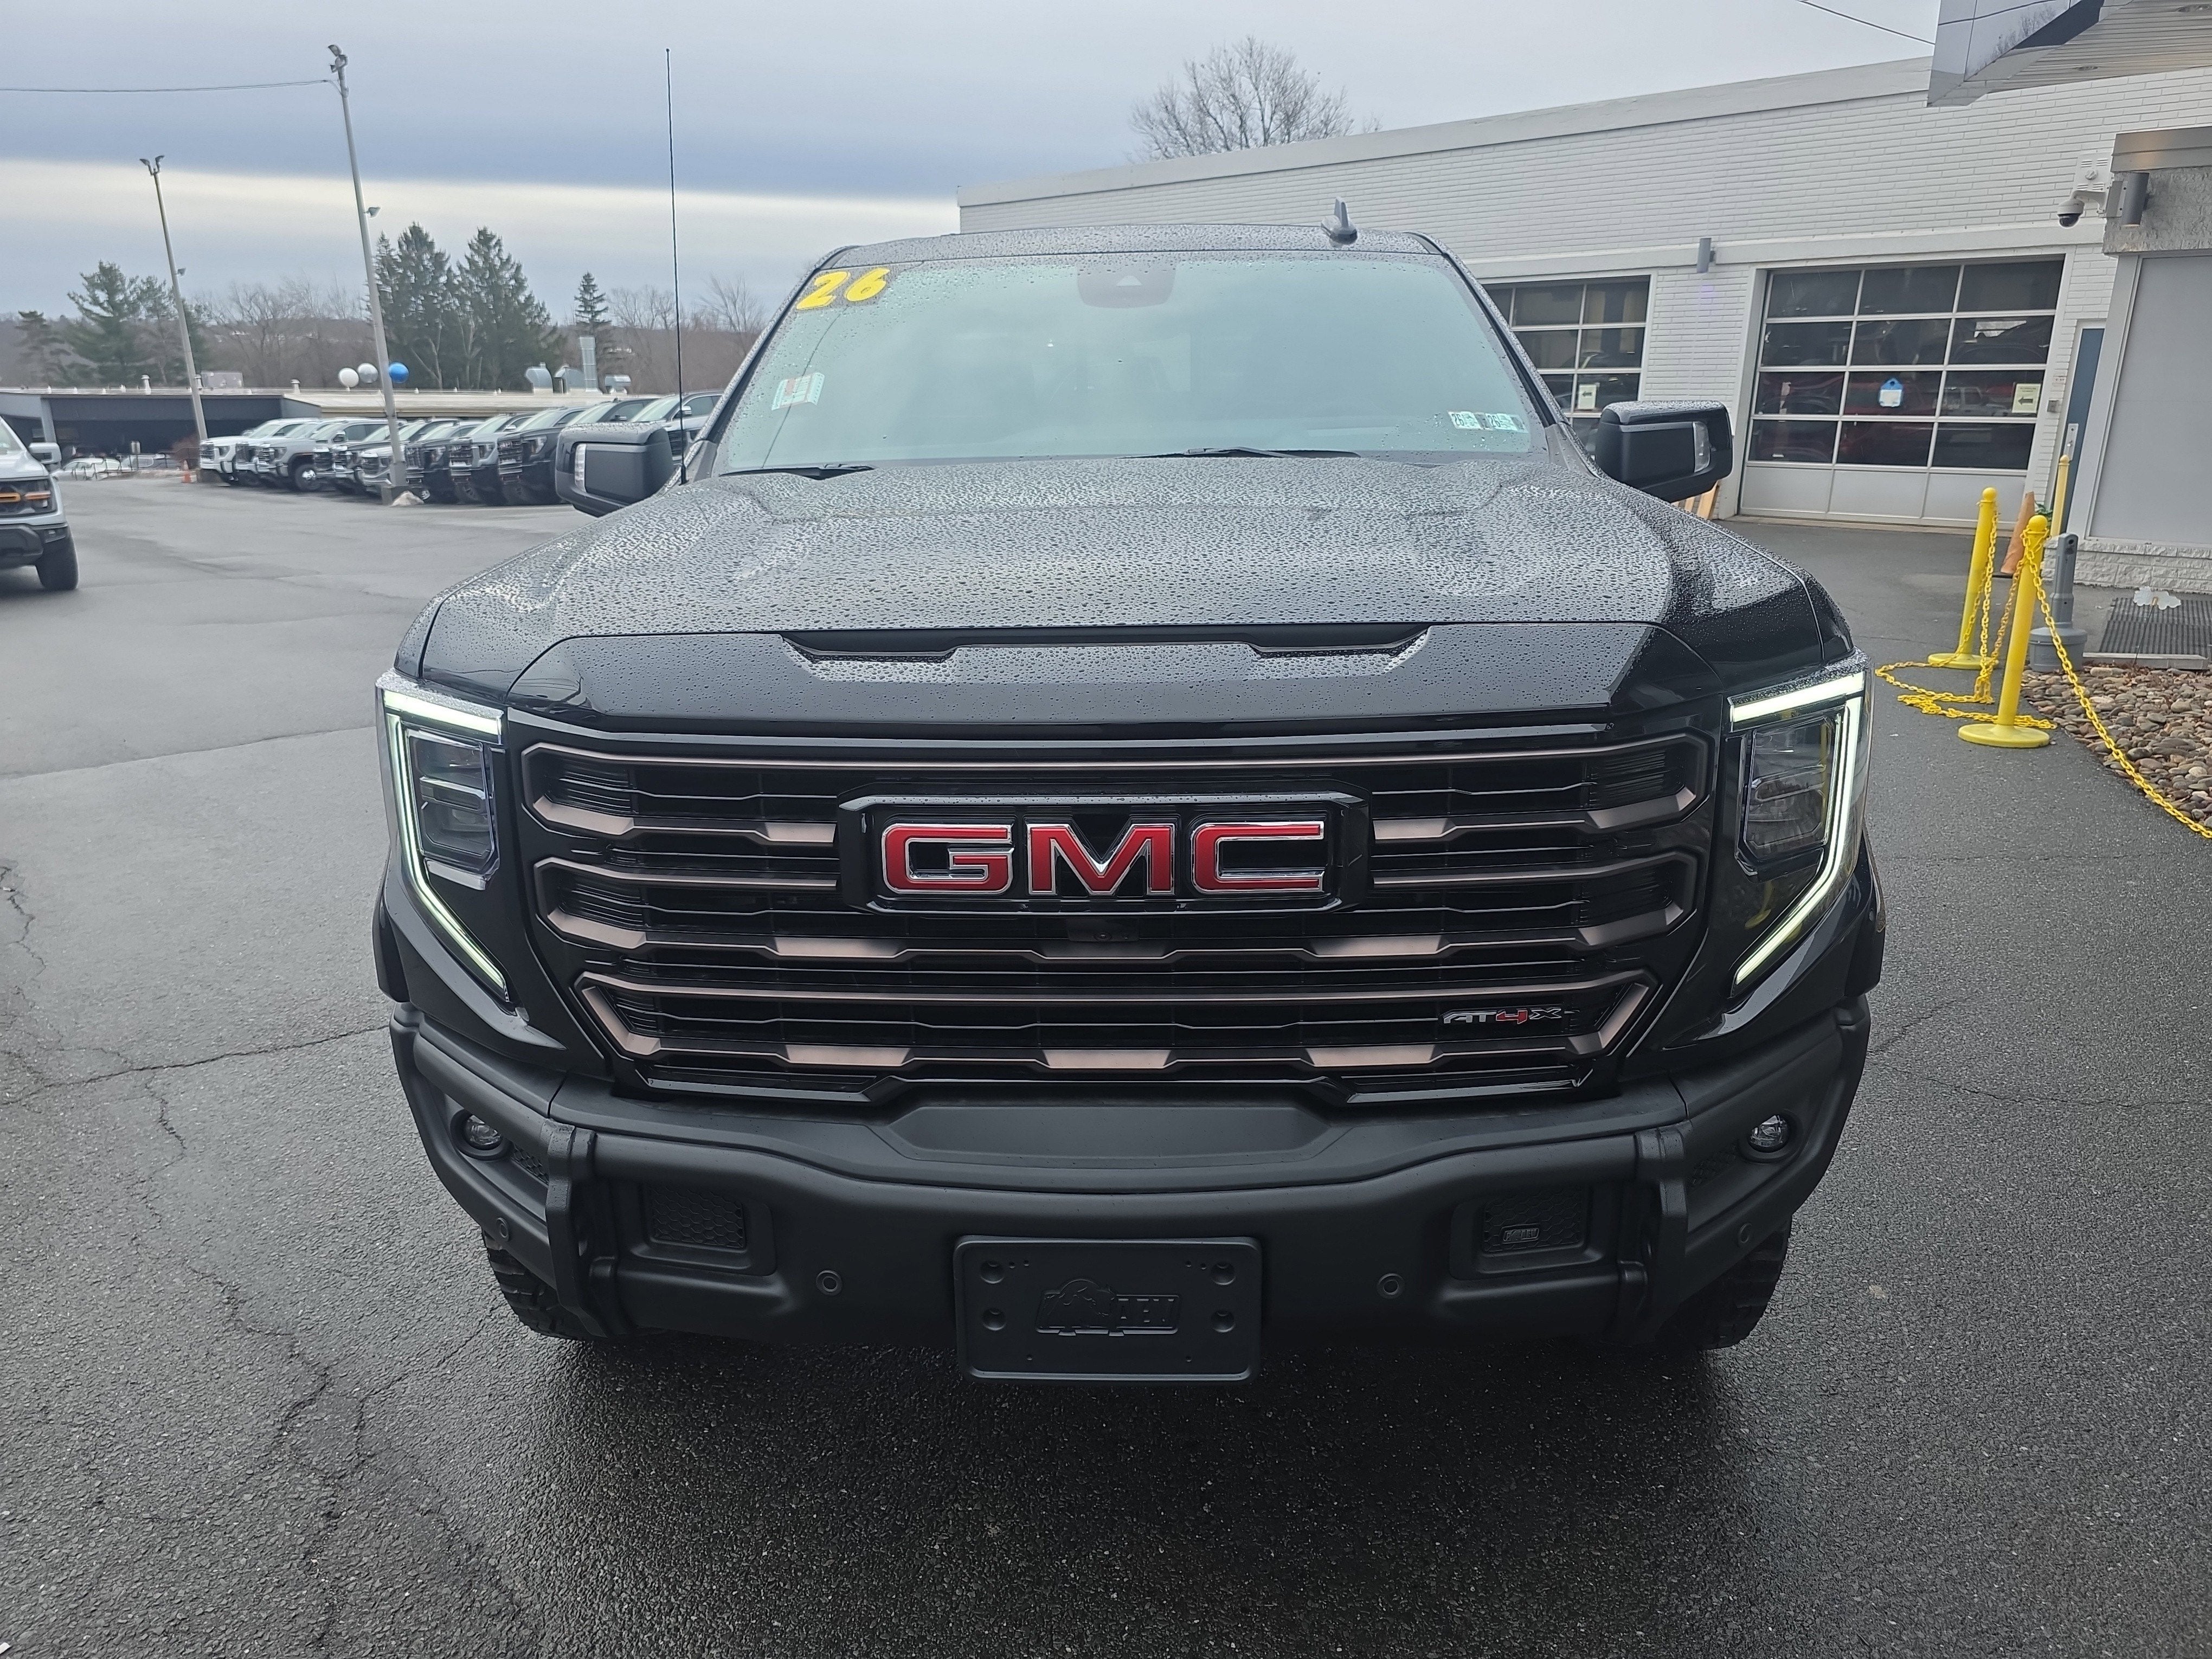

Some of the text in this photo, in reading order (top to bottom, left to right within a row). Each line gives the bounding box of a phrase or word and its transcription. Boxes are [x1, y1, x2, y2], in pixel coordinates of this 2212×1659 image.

[796, 268, 890, 310] 26
[881, 821, 1325, 895] GMC
[1443, 1008, 1562, 1024] AT4X
